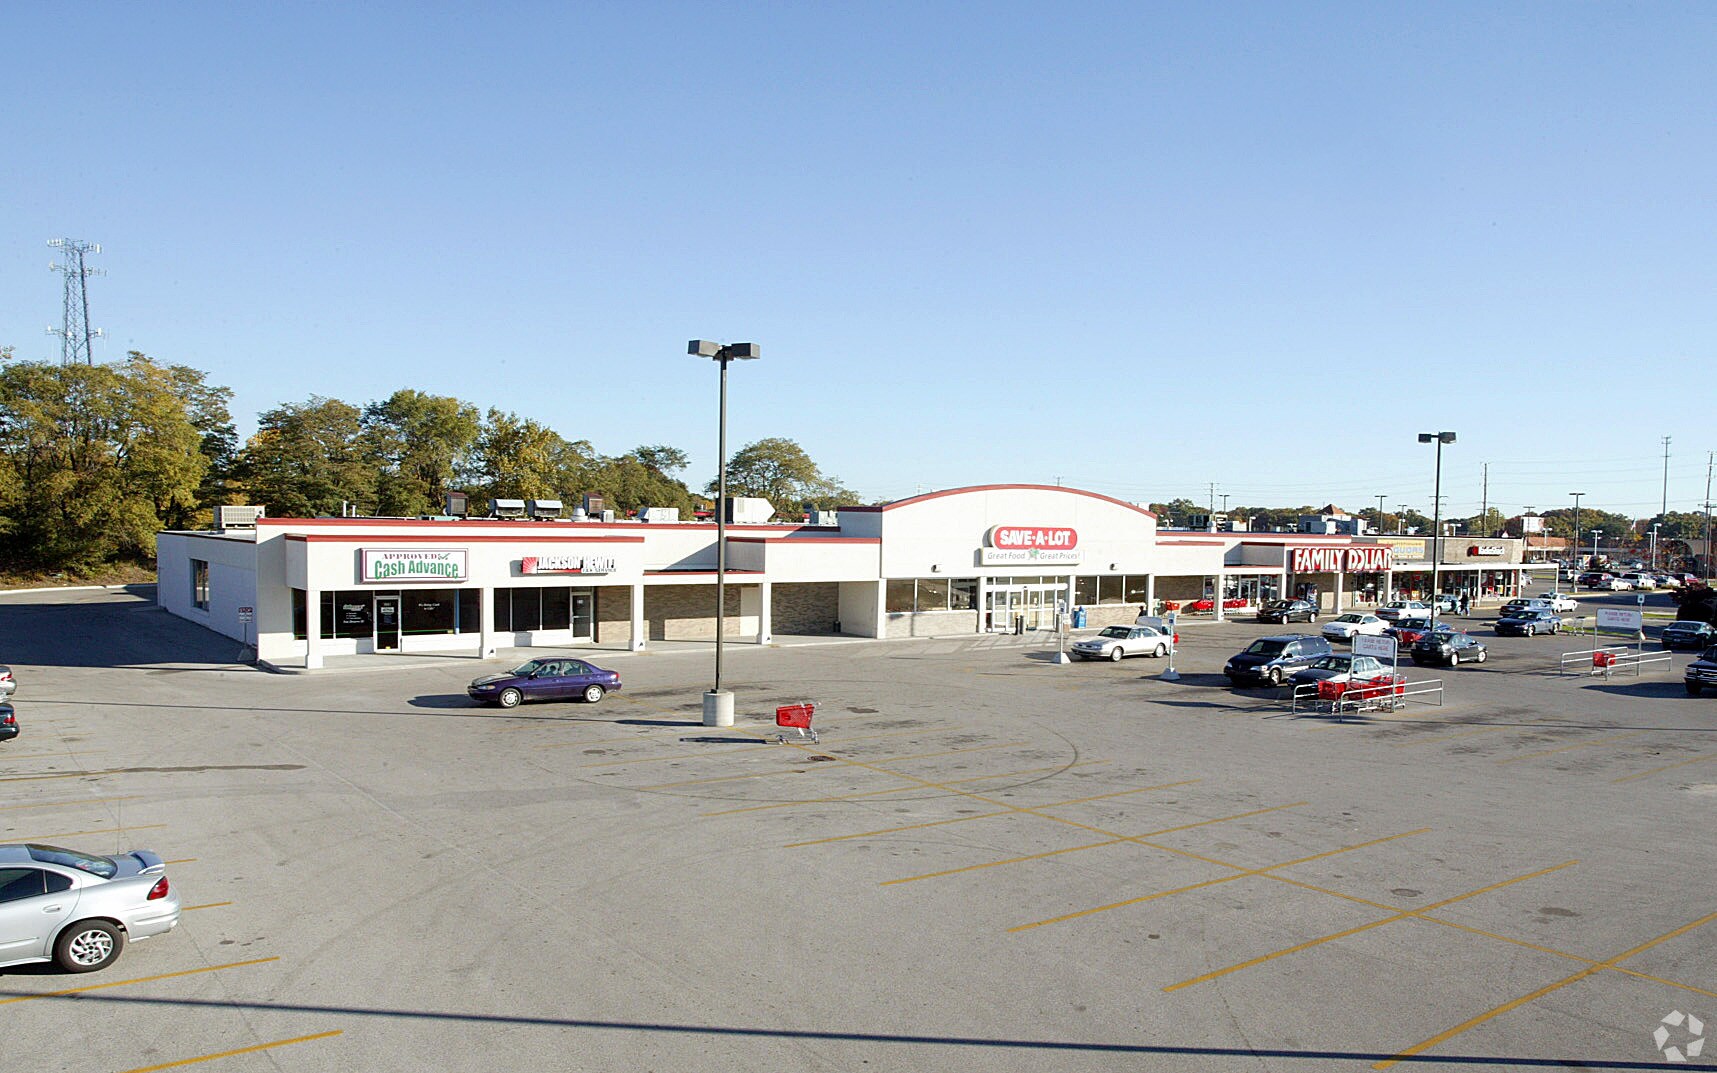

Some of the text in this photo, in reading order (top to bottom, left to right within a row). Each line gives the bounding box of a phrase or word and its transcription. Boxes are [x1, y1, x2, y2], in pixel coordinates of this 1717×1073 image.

[538, 557, 581, 569] JACKSON
[988, 552, 1007, 560] Great
[1008, 552, 1026, 560] Food
[1040, 552, 1058, 560] Great
[1294, 548, 1392, 571] FAMILY DOLLAR
[374, 560, 459, 580] Cash Advance
